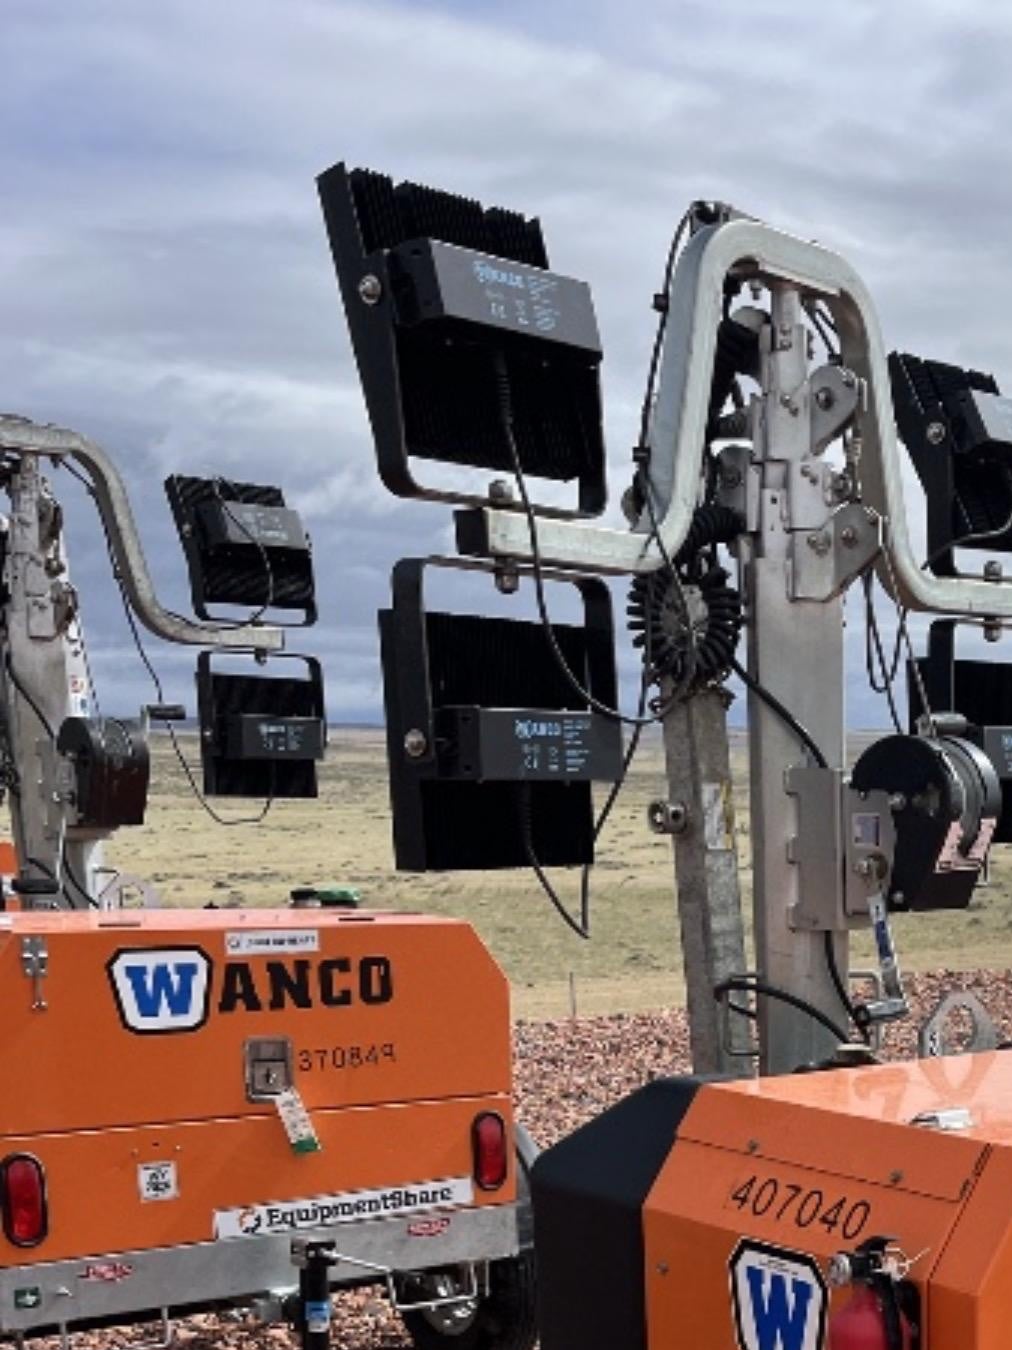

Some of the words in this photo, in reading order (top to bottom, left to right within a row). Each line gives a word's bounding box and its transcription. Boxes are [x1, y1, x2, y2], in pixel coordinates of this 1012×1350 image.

[124, 956, 393, 1018] WANCO
[298, 1043, 397, 1073] 370849
[265, 1186, 453, 1228] EquipmentShare
[731, 1174, 871, 1240] 407040
